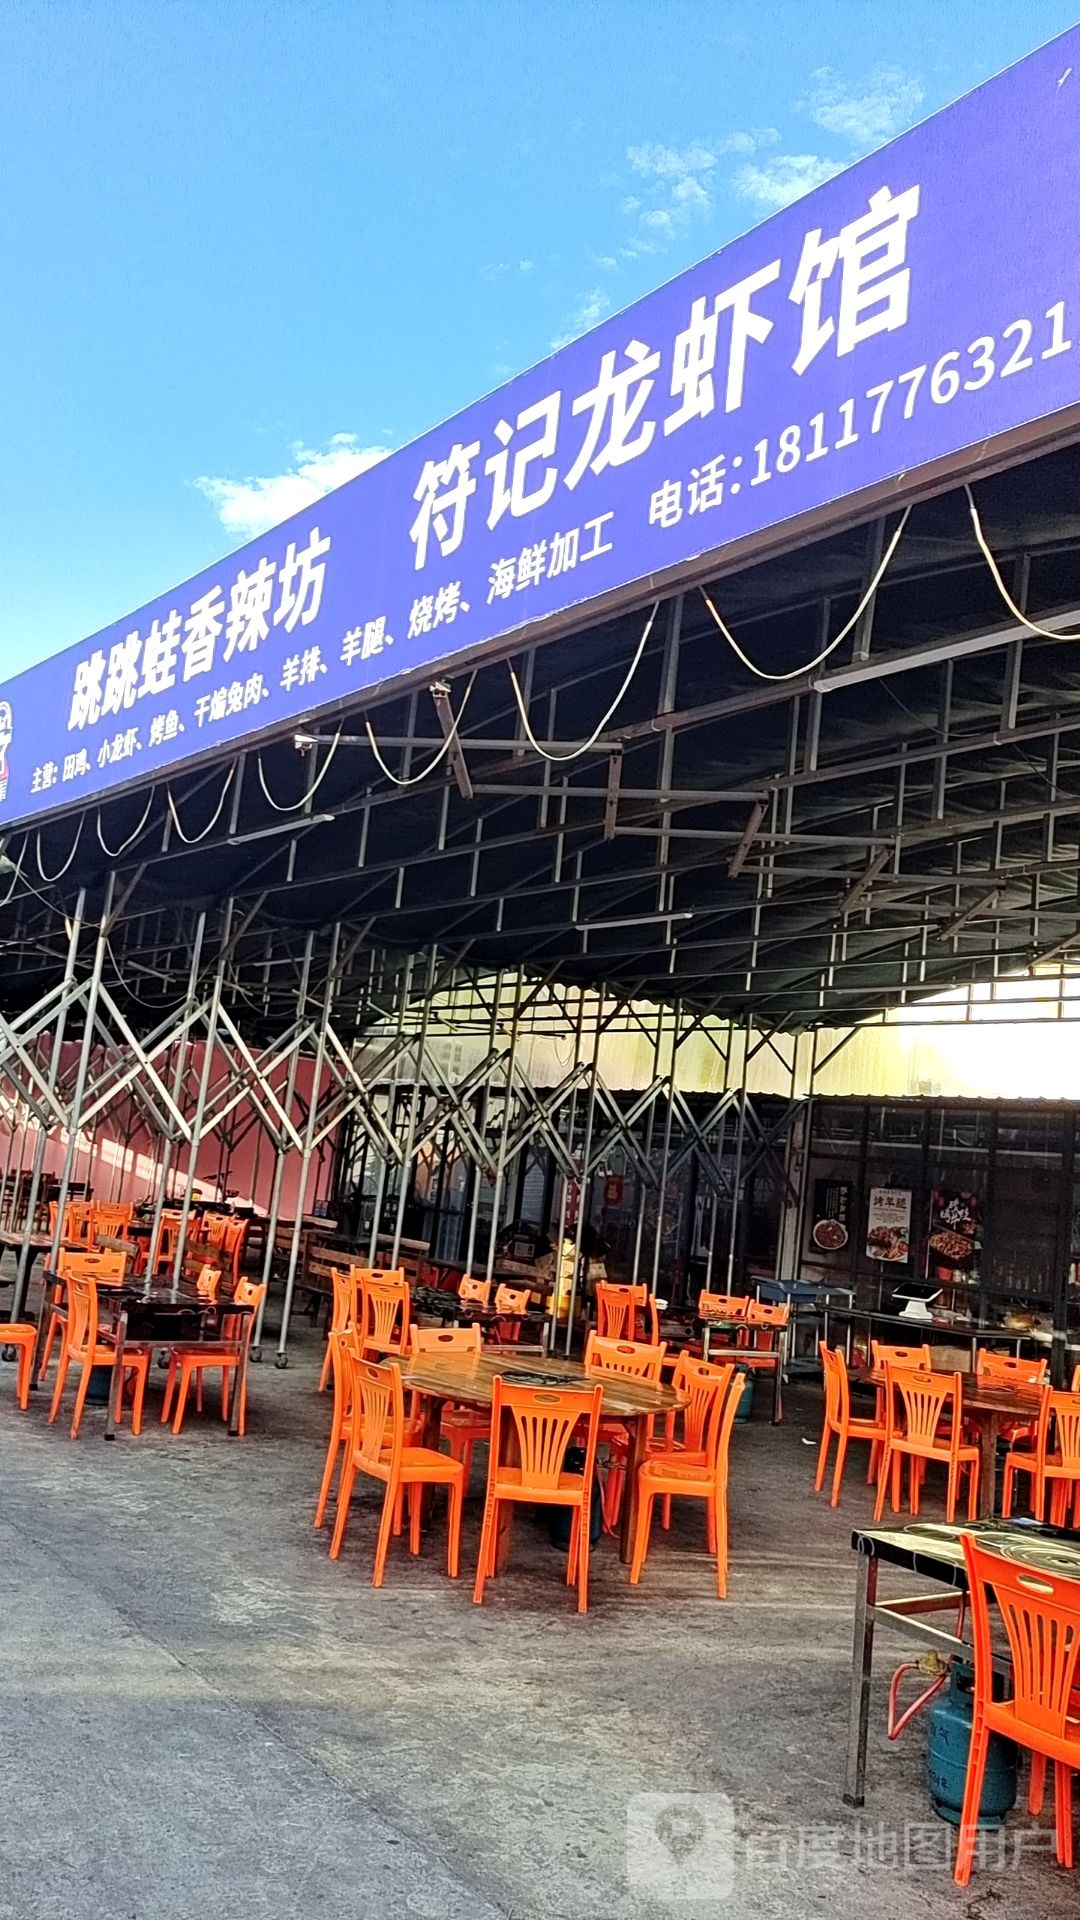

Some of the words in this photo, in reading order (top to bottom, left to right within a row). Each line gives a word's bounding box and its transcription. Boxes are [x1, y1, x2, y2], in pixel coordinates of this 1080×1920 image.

[409, 184, 920, 570] 符记龙虾馆
[67, 526, 331, 732] 跳跳蛙香辣坊
